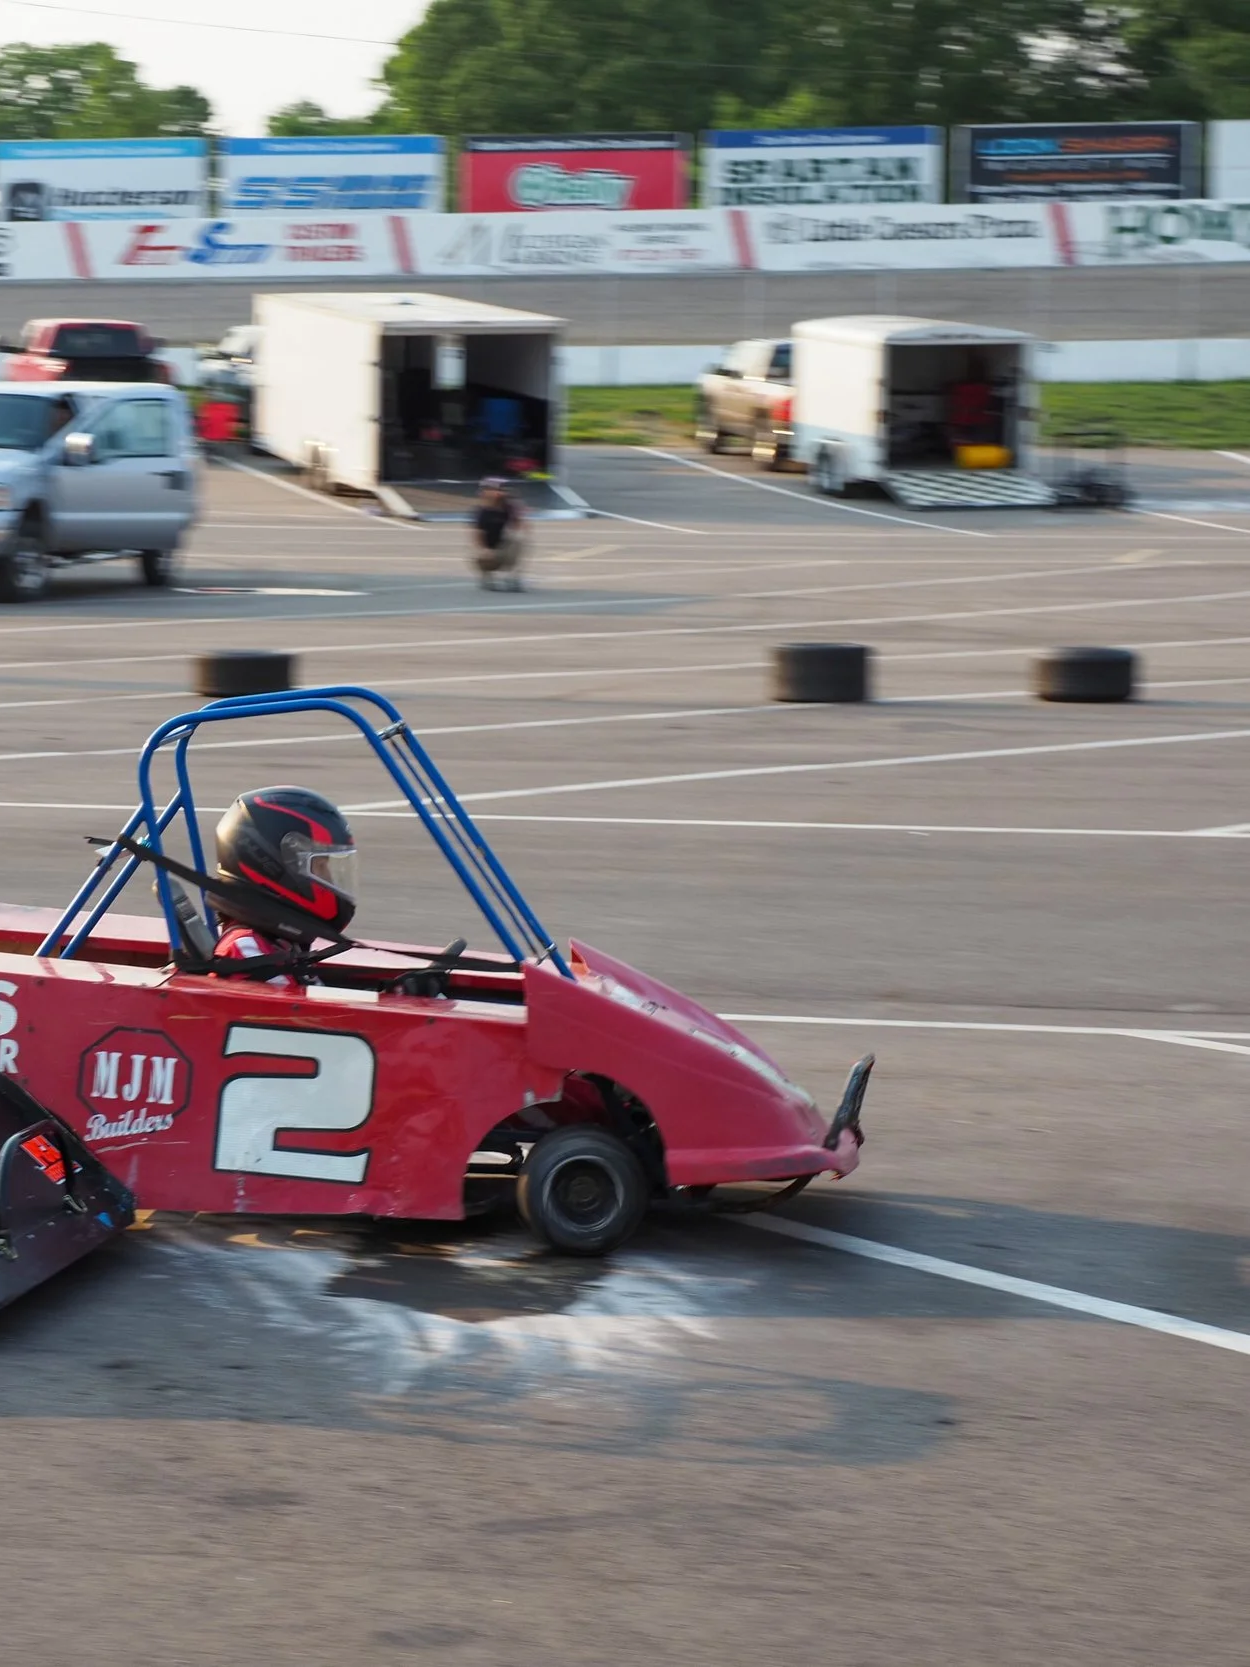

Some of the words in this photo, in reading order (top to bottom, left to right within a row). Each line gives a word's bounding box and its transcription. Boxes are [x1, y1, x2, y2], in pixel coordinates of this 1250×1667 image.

[90, 1051, 178, 1104] MJM
[212, 1022, 376, 1185] 2
[83, 1107, 174, 1141] Builders
